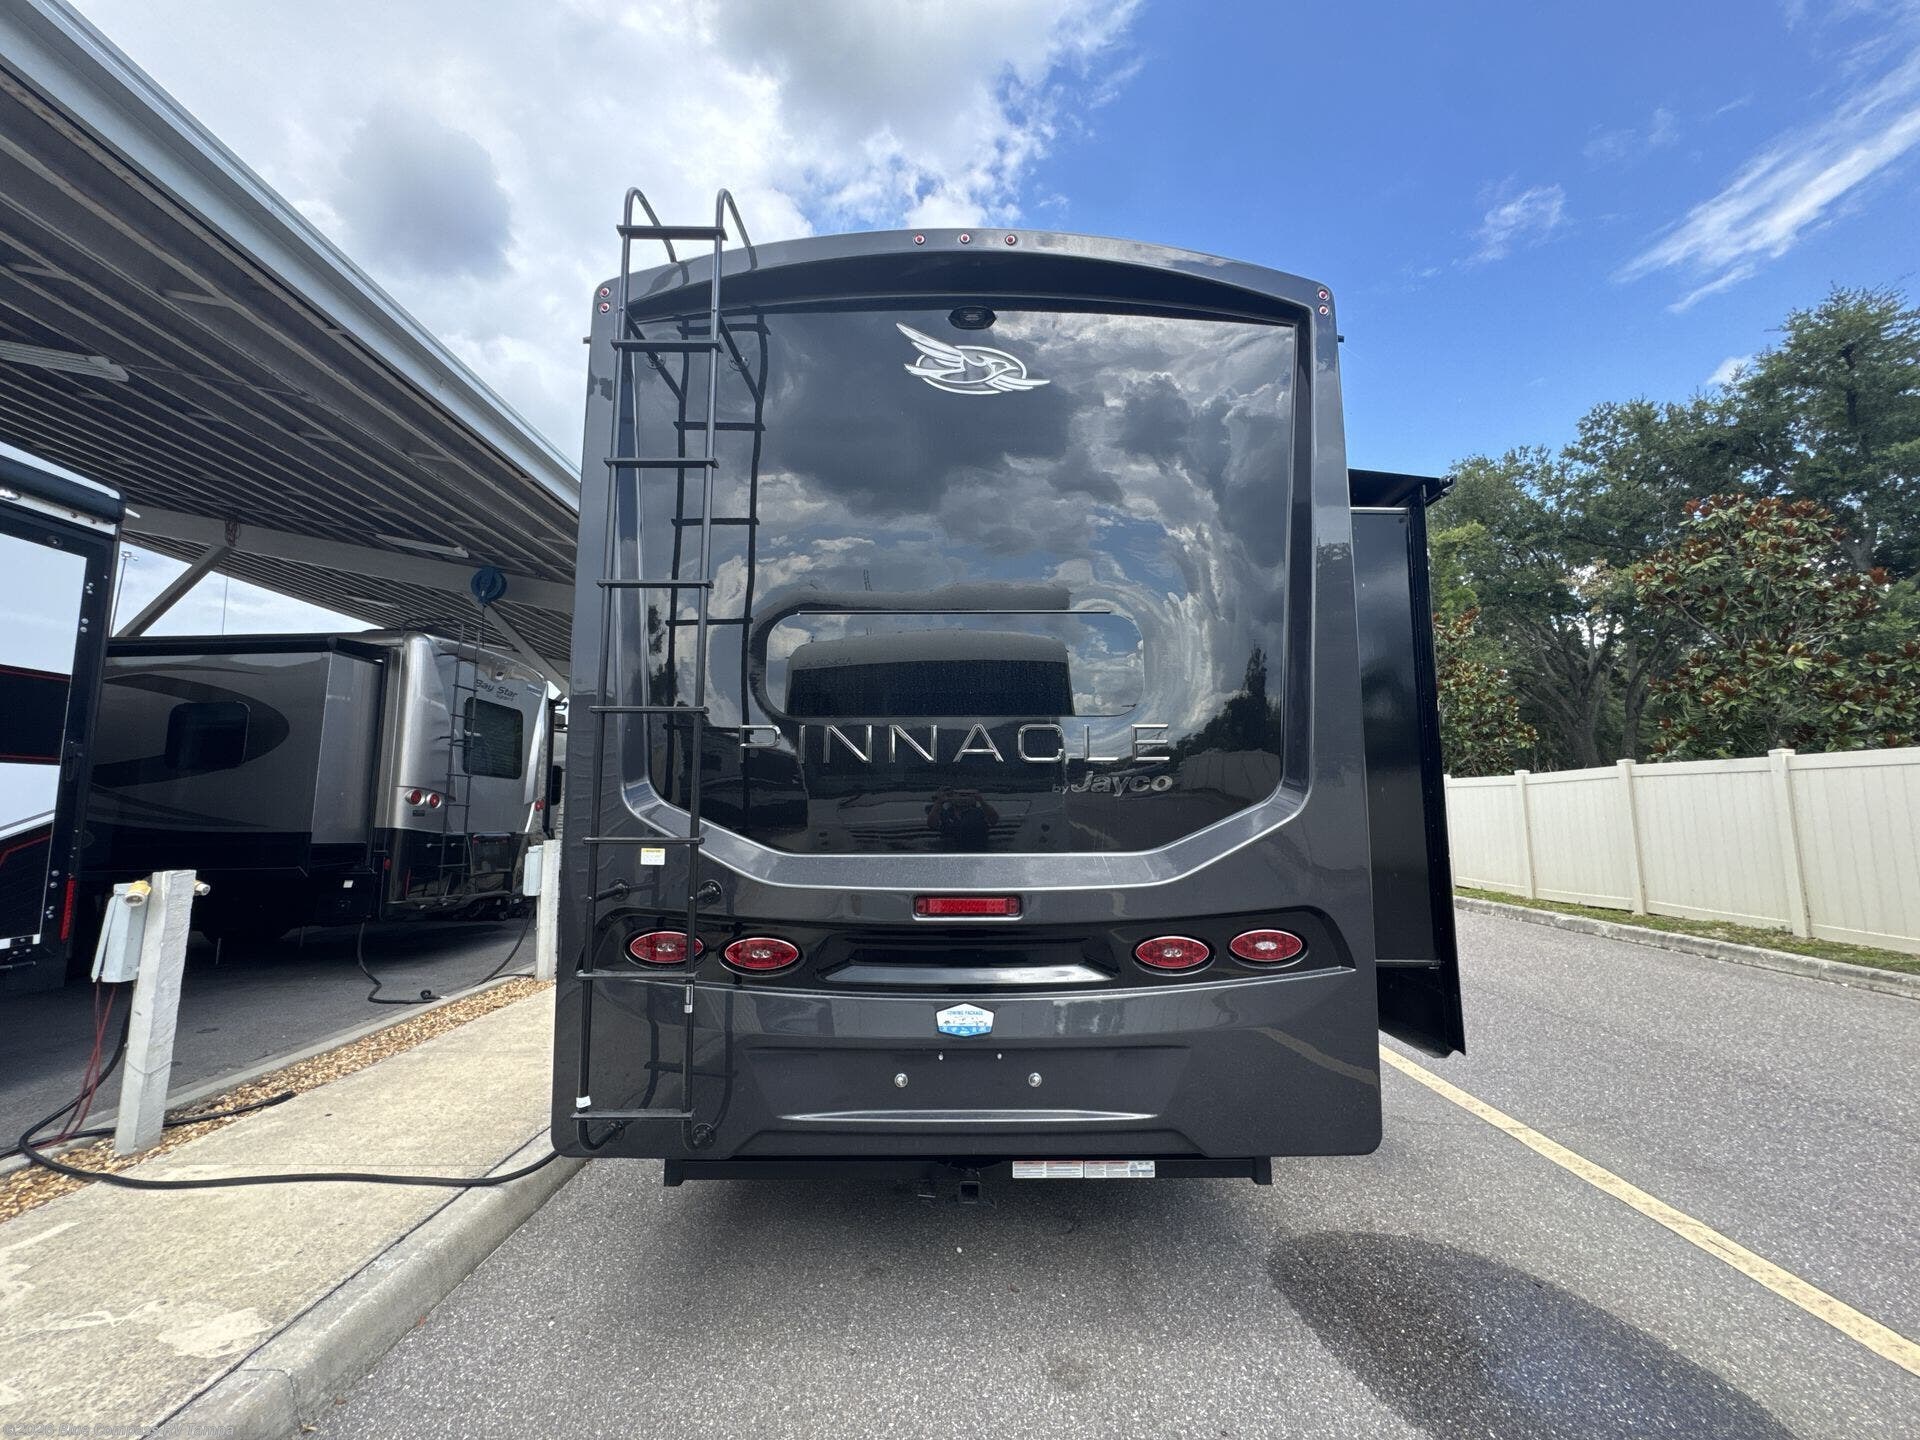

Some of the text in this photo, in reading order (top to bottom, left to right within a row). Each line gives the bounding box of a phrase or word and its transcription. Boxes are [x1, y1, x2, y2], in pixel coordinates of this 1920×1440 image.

[475, 679, 495, 692] Bay
[497, 686, 518, 698] Star
[739, 724, 1170, 763] PINNACLE
[1051, 771, 1173, 797] by Jayco
